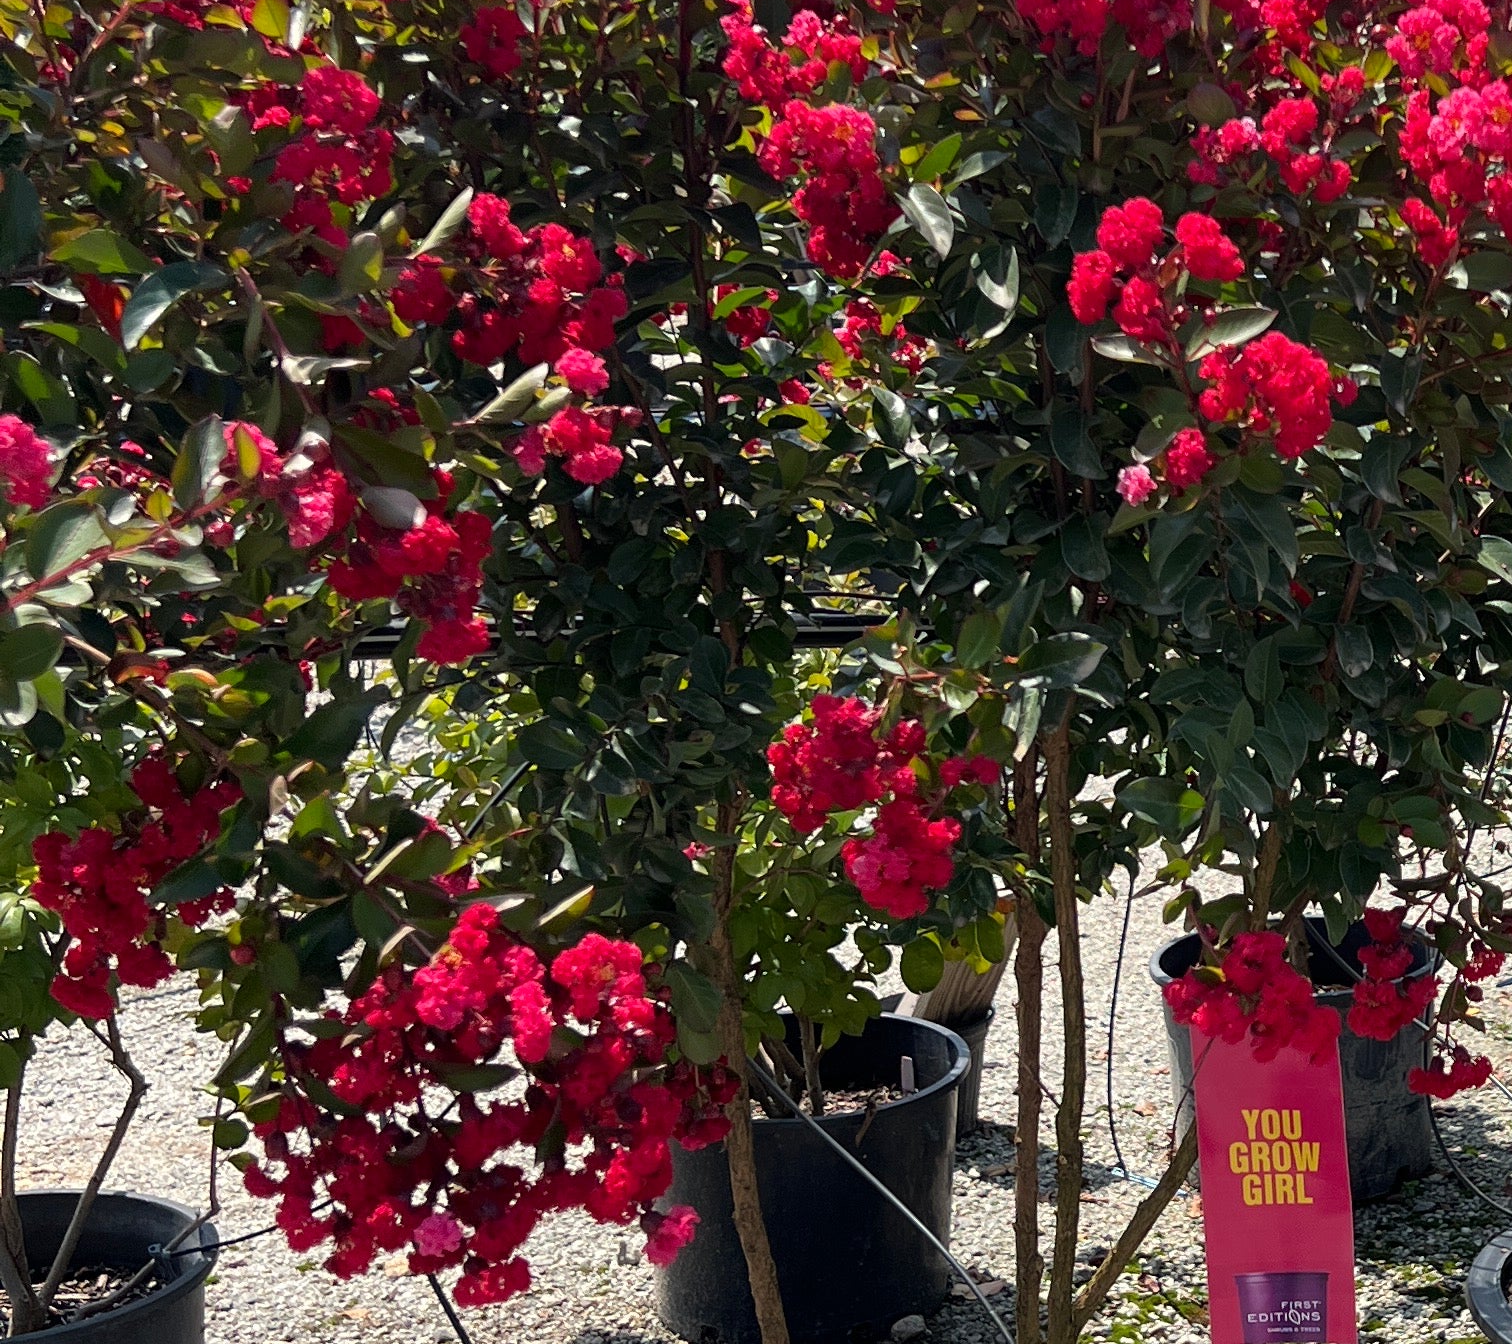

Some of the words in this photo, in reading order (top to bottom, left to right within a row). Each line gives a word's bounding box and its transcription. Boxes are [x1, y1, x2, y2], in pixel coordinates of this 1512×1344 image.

[1242, 1109, 1303, 1140] YOU
[1229, 1142, 1320, 1174] GROW
[1242, 1174, 1313, 1206] GIRL
[1247, 1311, 1321, 1325] EDITIONS
